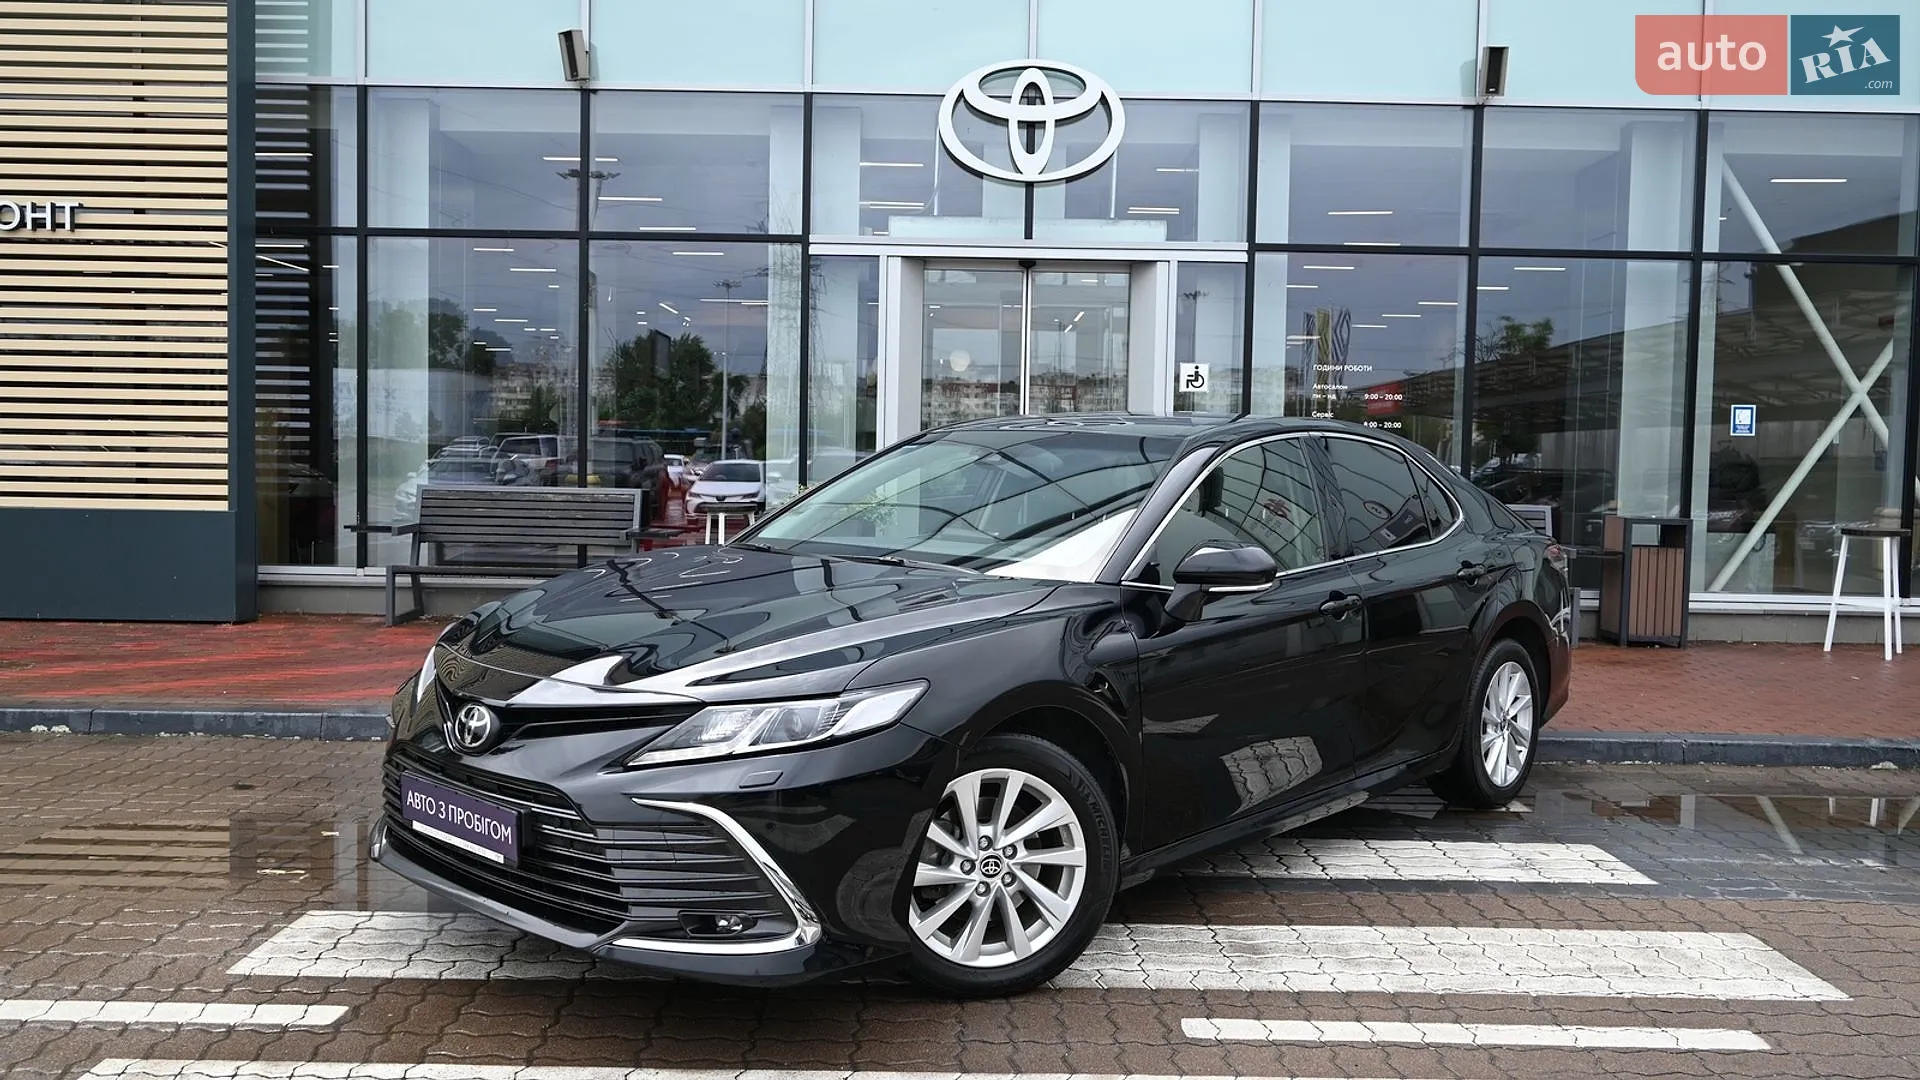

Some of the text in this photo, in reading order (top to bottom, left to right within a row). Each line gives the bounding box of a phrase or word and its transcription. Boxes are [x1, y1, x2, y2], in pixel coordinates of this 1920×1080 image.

[1313, 364, 1373, 372] ГОДИНИ РОБОТИ
[1384, 393, 1403, 401] 20:00
[1311, 411, 1334, 419] Сервіс
[1383, 421, 1402, 429] 20:00
[407, 789, 436, 815] АВТО
[448, 804, 512, 845] ПРОБІГОМ
